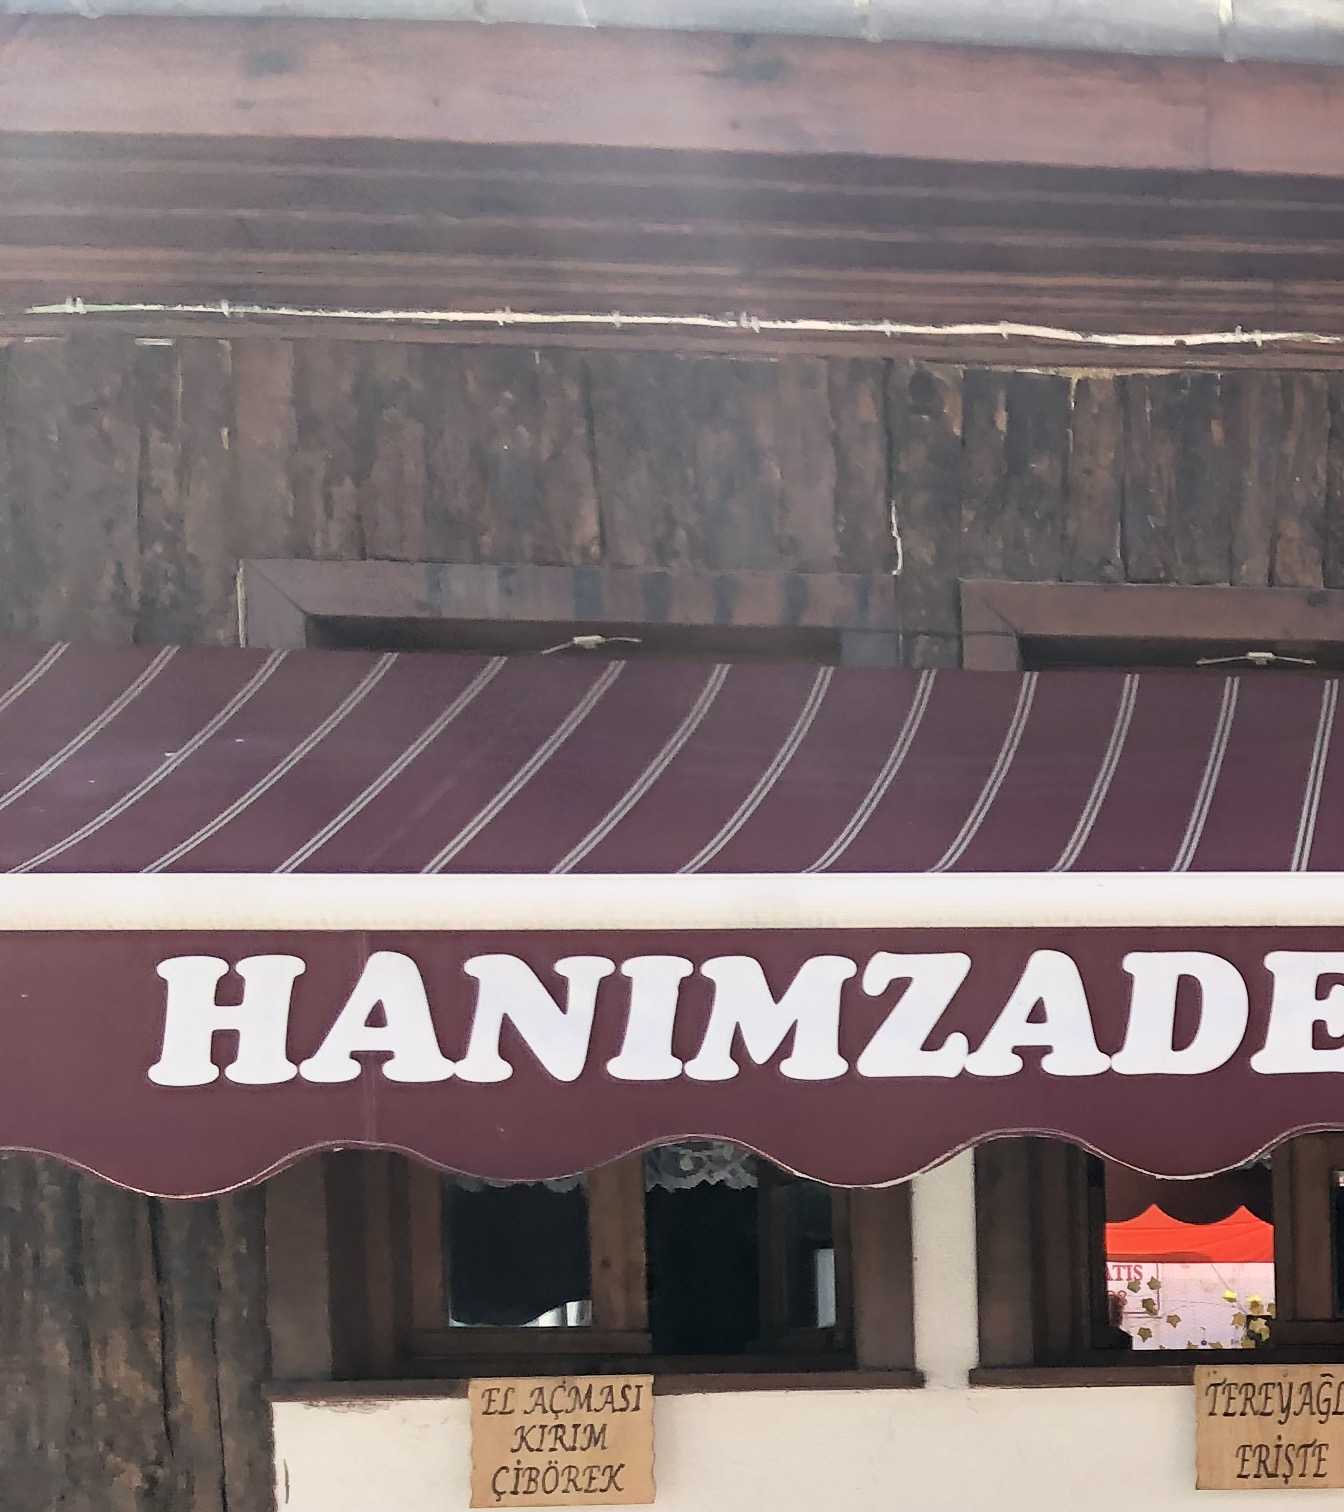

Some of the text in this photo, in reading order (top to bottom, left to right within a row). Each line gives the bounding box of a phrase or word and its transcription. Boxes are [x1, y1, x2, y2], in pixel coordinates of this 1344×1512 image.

[481, 1383, 644, 1420] EL AÇMASI
[510, 1422, 608, 1454] KIRIM
[1235, 1434, 1330, 1485] ERİŞTE
[491, 1458, 627, 1503] ÇİBÖREK
